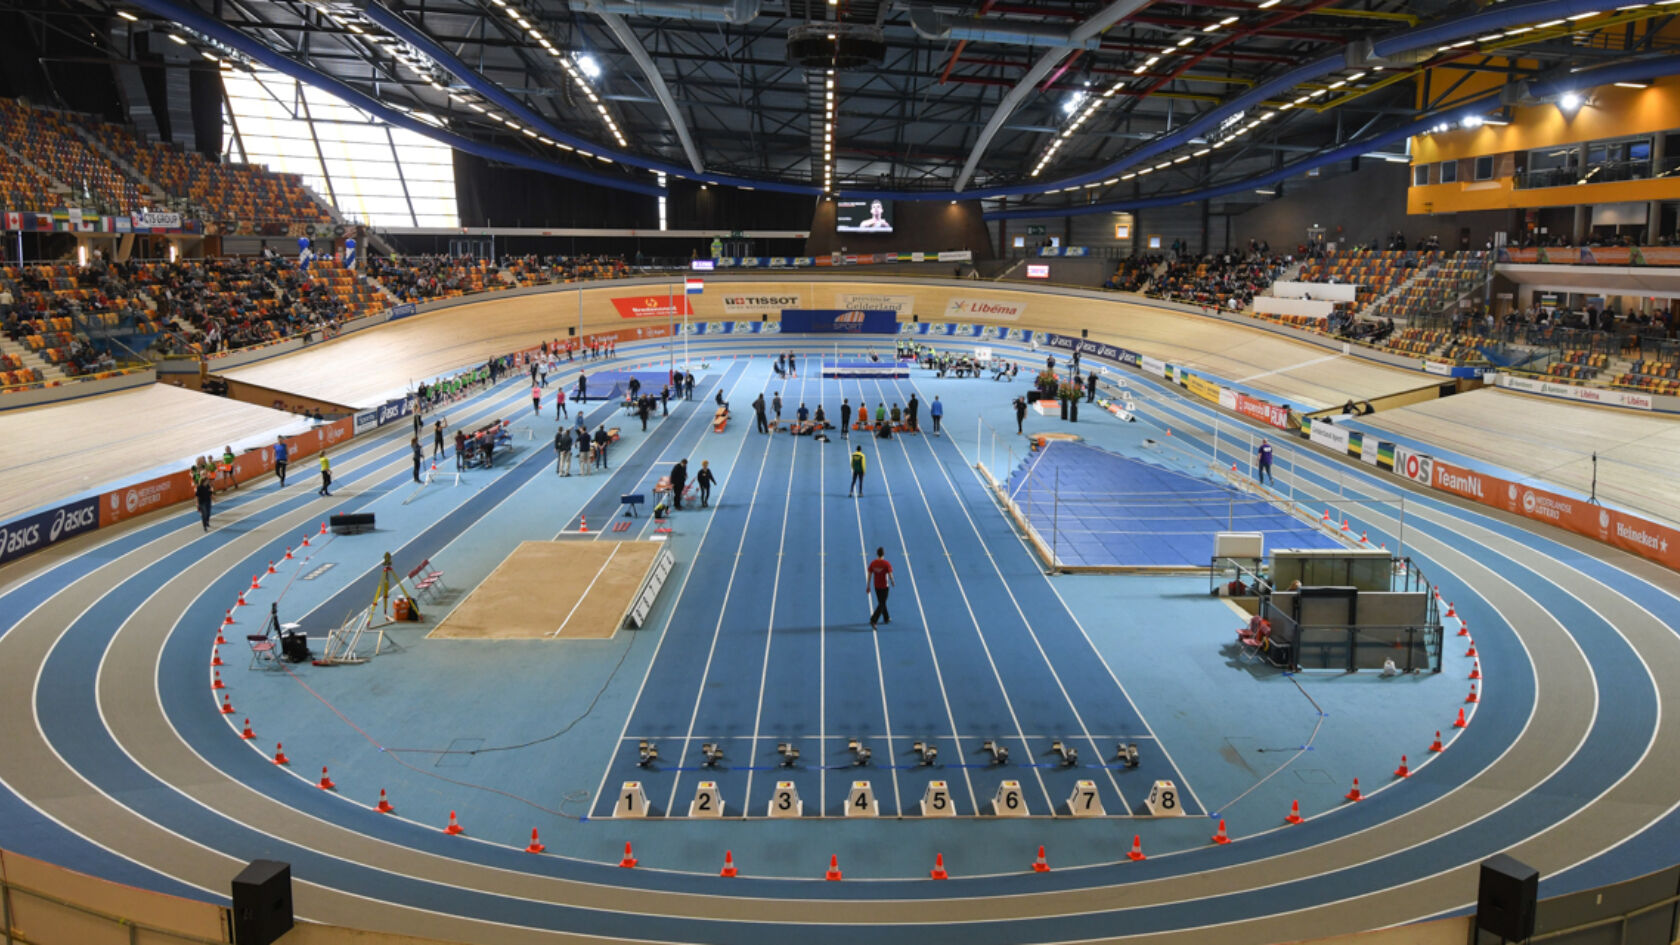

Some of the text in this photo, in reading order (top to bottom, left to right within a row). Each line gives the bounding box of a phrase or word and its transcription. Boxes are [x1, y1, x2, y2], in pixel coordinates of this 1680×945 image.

[746, 296, 798, 305] TISSOT
[846, 302, 902, 311] Gelderland
[970, 302, 1017, 315] Libéma
[1271, 410, 1288, 427] RUN
[1395, 450, 1430, 483] NOS
[1437, 466, 1484, 498] TeamNL
[7, 523, 40, 553] asics
[1616, 522, 1659, 550] Heineken
[625, 793, 633, 810] 1
[698, 793, 711, 810] 2
[778, 792, 791, 810] 3
[855, 792, 868, 810] 4
[933, 792, 946, 809] 5
[1006, 791, 1019, 809] 6
[1083, 792, 1095, 809] 7
[1161, 791, 1175, 809] 8
